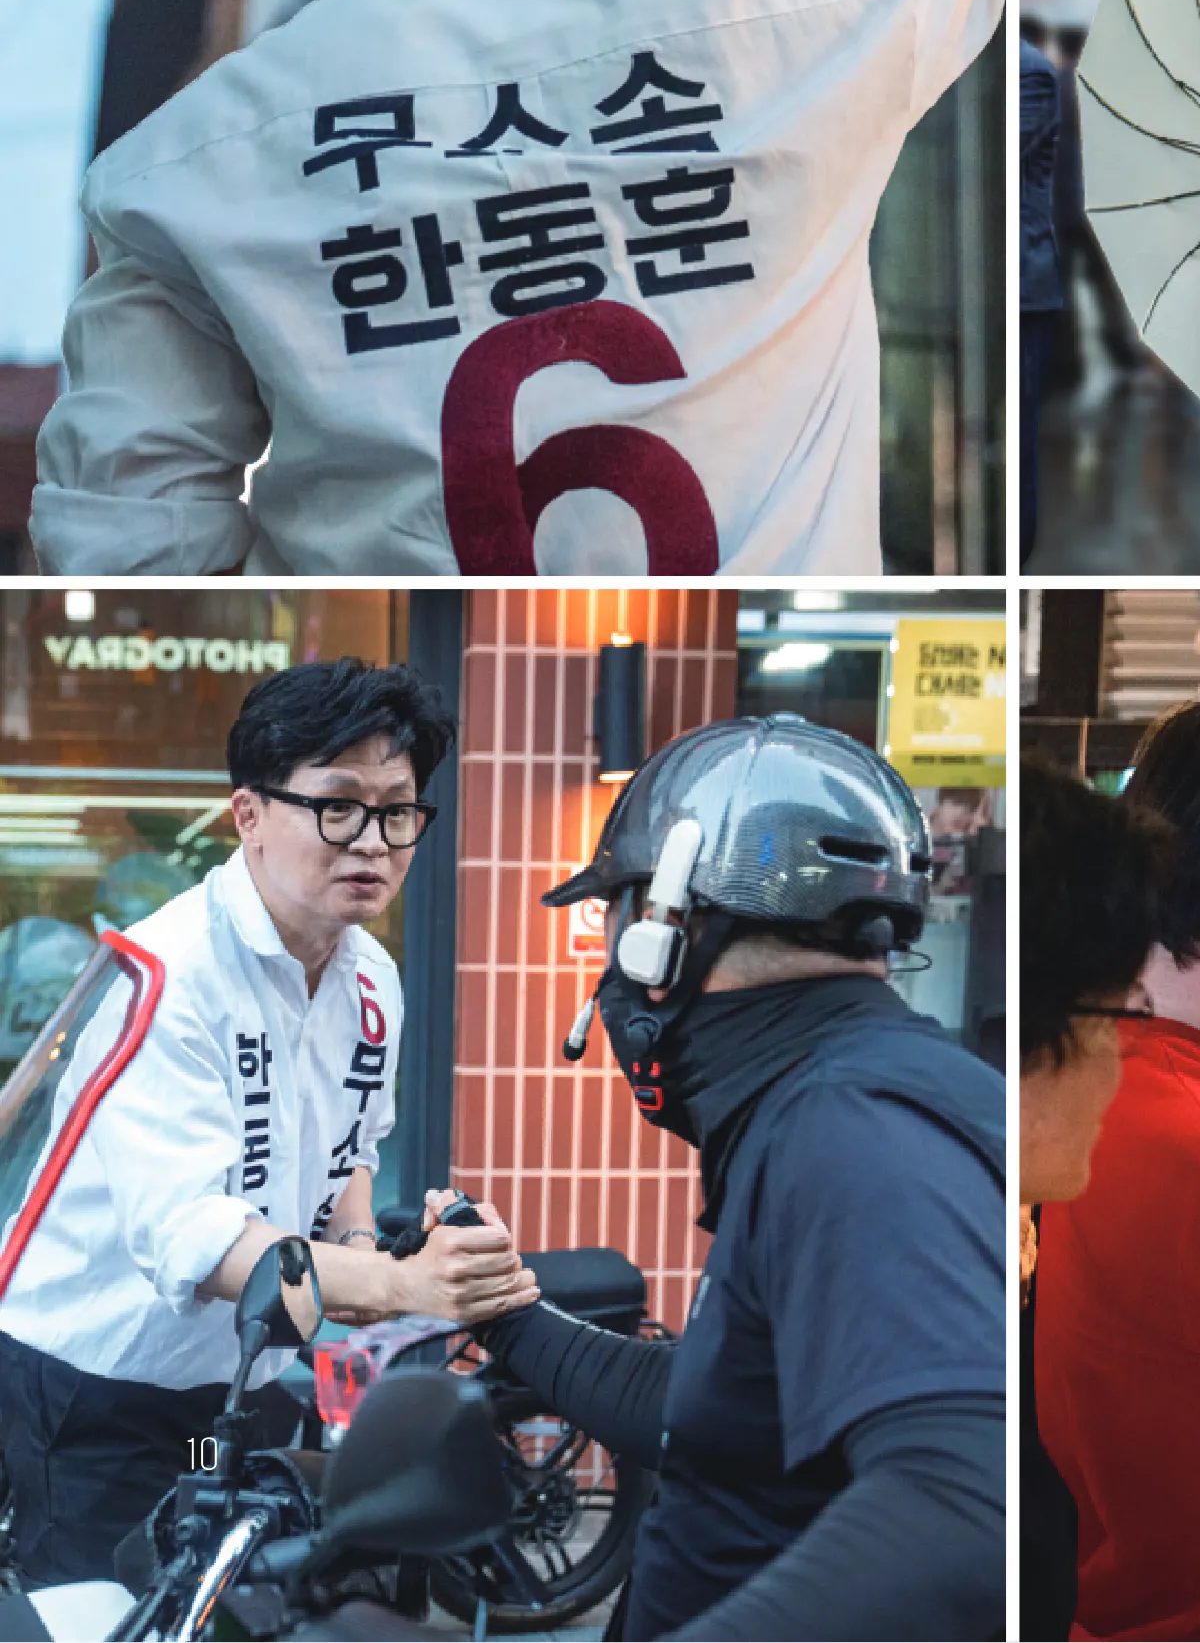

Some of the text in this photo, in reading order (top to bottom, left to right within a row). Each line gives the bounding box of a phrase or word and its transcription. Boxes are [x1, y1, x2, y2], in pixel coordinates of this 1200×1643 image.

[301, 50, 725, 192] 무소속
[320, 164, 755, 356] 한동훈
[441, 298, 720, 575] 6
[236, 1032, 272, 1217] 한동
